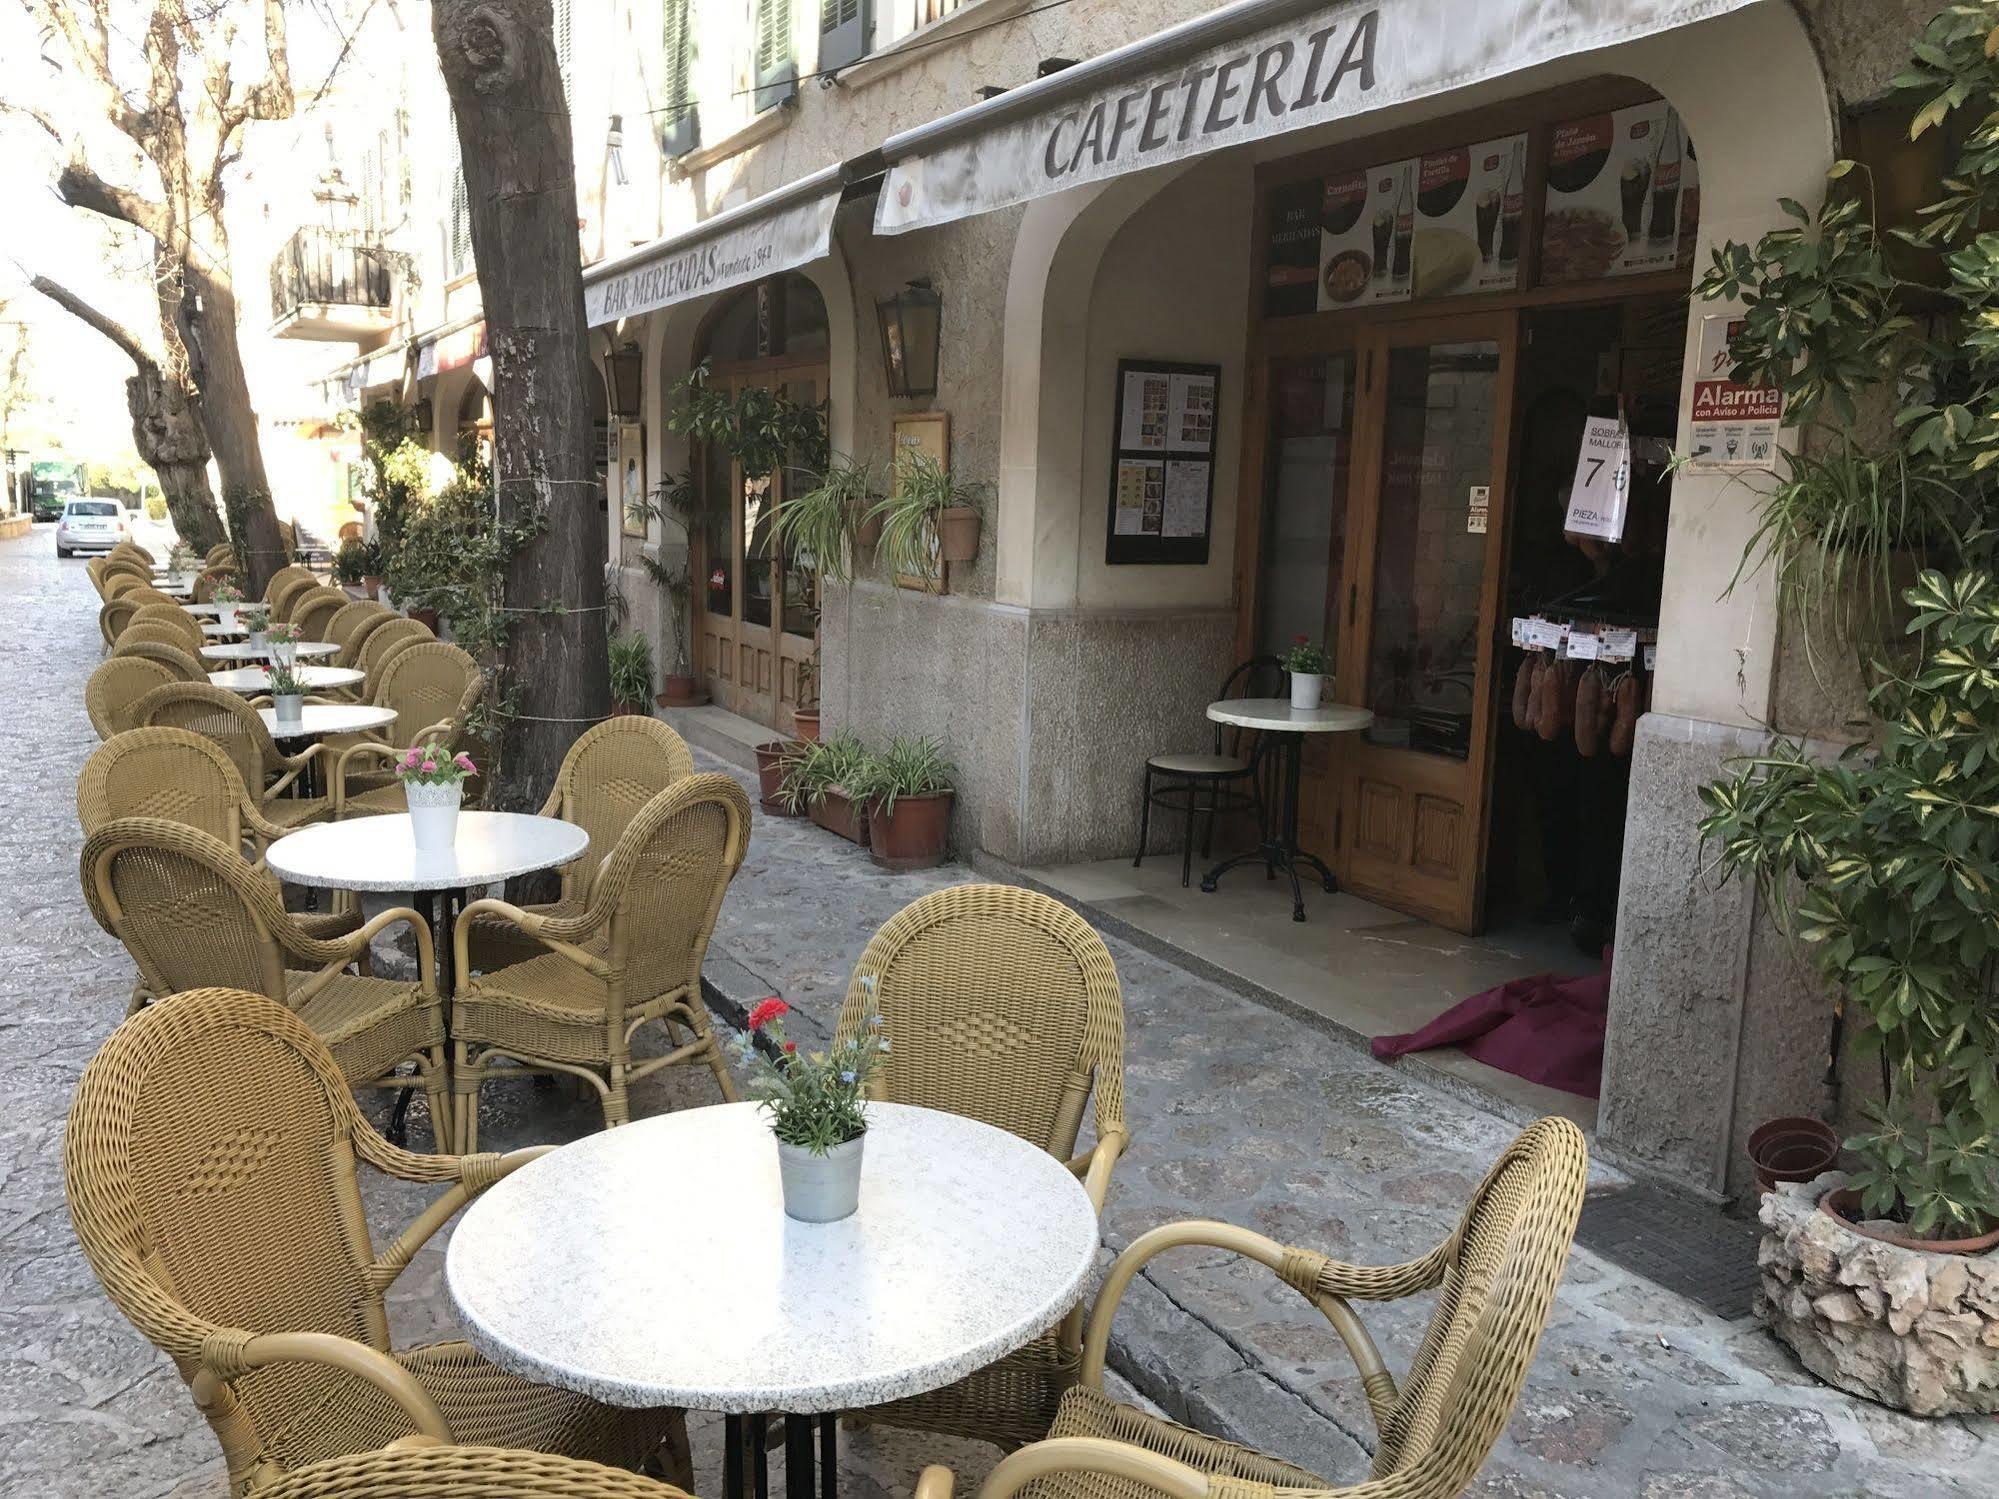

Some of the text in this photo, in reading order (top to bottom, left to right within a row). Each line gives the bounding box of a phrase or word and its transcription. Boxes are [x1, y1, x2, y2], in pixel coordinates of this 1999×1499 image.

[1044, 9, 1379, 180] CAFETERIA
[604, 278, 630, 315] BAR
[631, 245, 718, 308] MERIENDAS
[1697, 385, 1779, 407] Alarma
[1695, 409, 1711, 417] con
[1713, 406, 1737, 417] Aviso
[1585, 457, 1605, 487] 7
[1572, 508, 1598, 520] PIEZA
